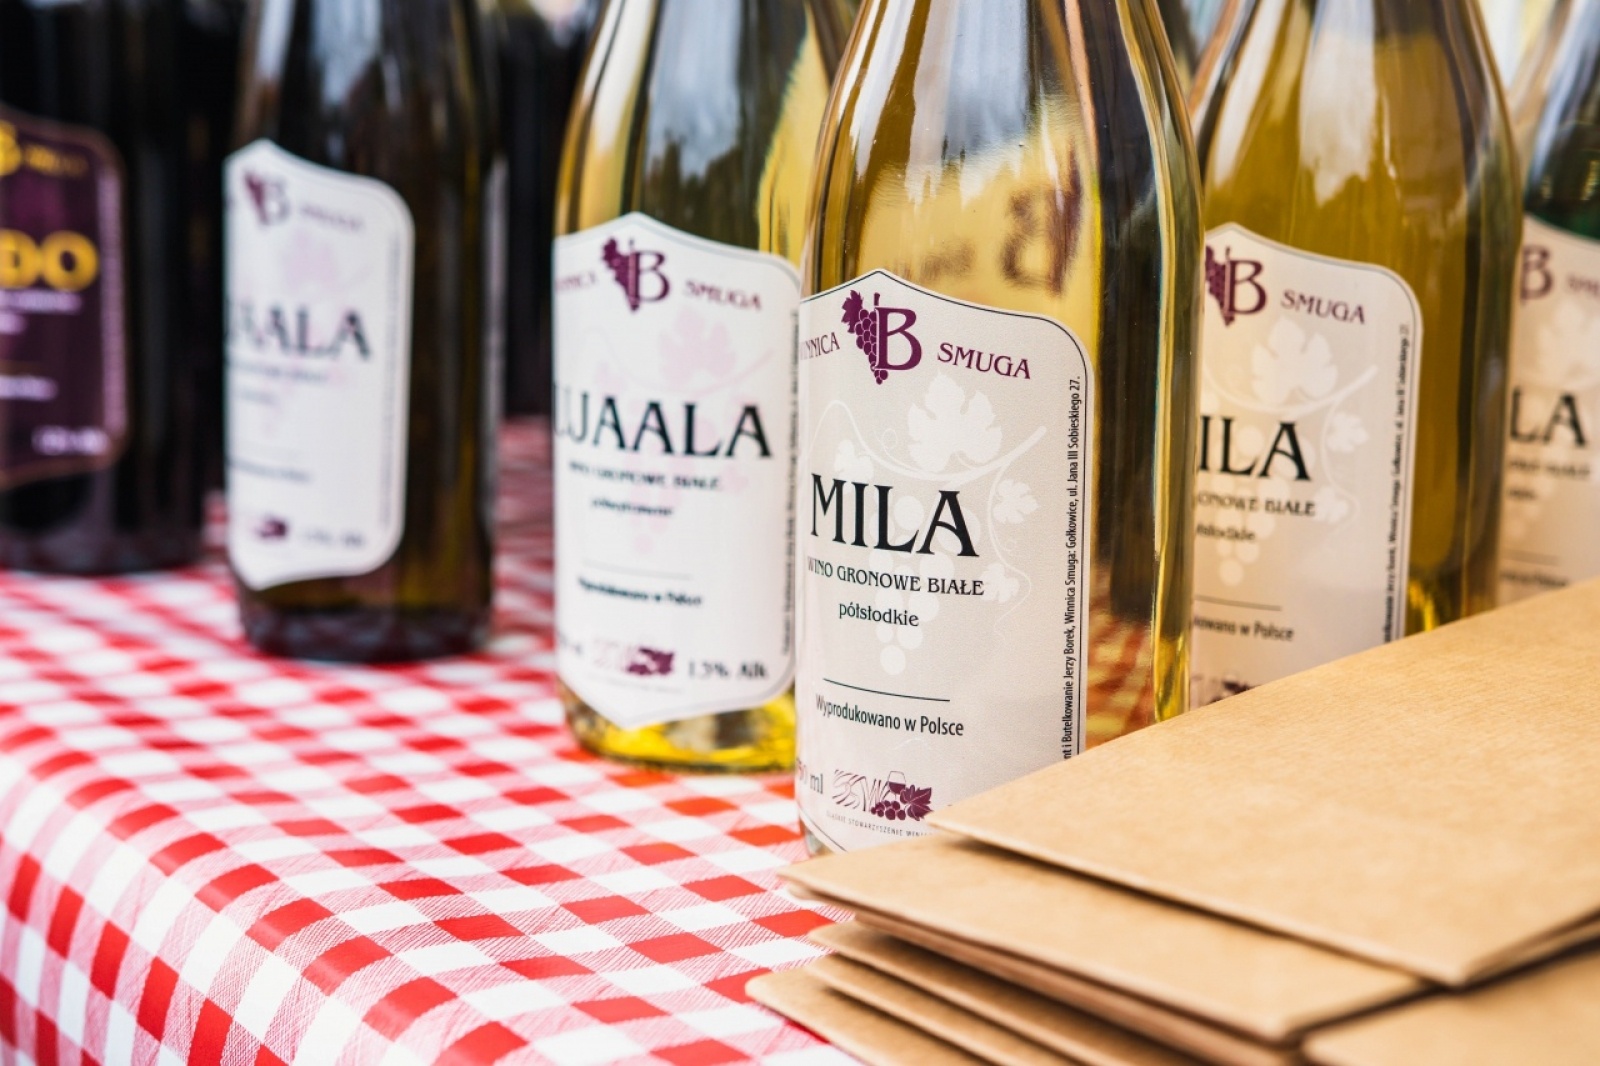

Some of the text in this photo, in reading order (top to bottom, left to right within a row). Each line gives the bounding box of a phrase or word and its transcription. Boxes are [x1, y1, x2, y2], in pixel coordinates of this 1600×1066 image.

[634, 249, 671, 303] B
[1229, 259, 1267, 316] B
[685, 280, 762, 311] SMUGA
[1281, 289, 1366, 325] SMUGA
[875, 307, 922, 371] B
[937, 342, 1031, 380] SMUGA
[1069, 375, 1081, 391] 27.
[1068, 393, 1081, 449] Sobieskiego
[1199, 415, 1311, 481] ILA
[1067, 462, 1079, 483] Jana
[1067, 485, 1078, 497] ul.
[811, 473, 980, 557] MILA
[1065, 498, 1079, 549] Gołkowice,
[837, 566, 921, 592] GRONOWE
[928, 578, 985, 597] BIAŁE
[1065, 551, 1078, 585] Smuga:
[839, 601, 919, 627] półsłodkie
[1064, 588, 1076, 624] Winnica
[1063, 625, 1076, 654] Borek,
[1063, 656, 1076, 679] Jerzy
[815, 693, 964, 737] Wyprodukowano w Polsce
[1061, 681, 1074, 742] Butelkowanie
